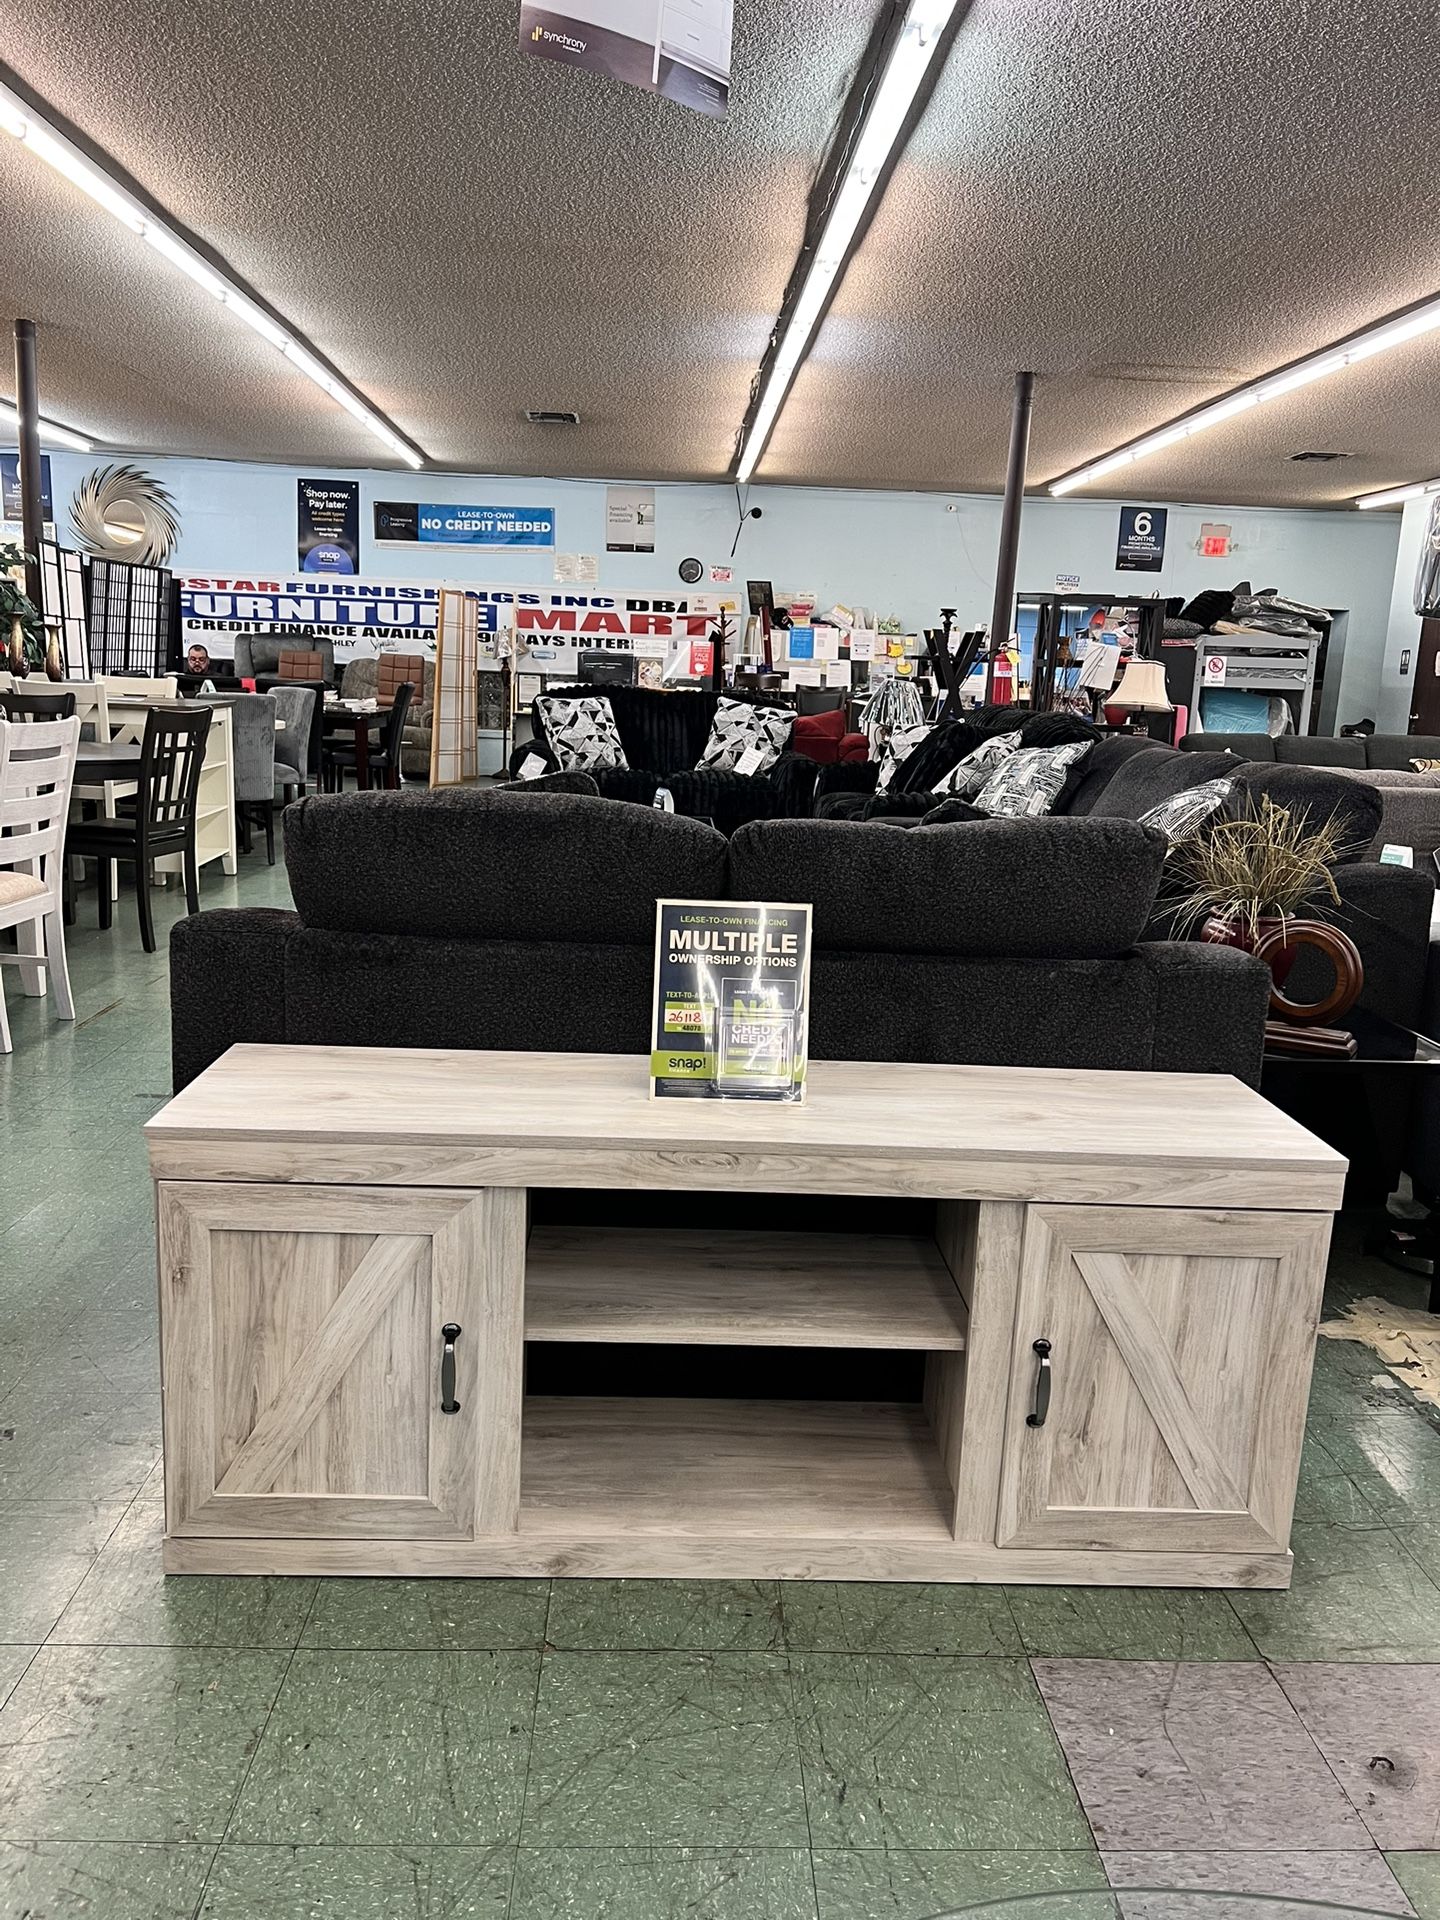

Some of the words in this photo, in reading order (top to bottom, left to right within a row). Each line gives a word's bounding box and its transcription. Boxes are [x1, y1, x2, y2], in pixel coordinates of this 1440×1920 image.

[543, 30, 587, 51] synchrony
[305, 488, 328, 499] Shop
[329, 491, 351, 500] now.
[309, 499, 325, 510] Pay
[325, 500, 348, 509] later.
[457, 510, 515, 520] LEASE-TO-OWN
[421, 518, 442, 531] NO
[445, 519, 492, 532] CREDIT
[496, 520, 551, 533] NEEDED
[1133, 511, 1152, 536] 6
[1128, 535, 1156, 543] MONTHS
[1204, 537, 1227, 555] EXIT
[318, 551, 341, 561] snap
[180, 578, 281, 592] STAR
[286, 582, 541, 604] FURNISHNGS
[551, 595, 615, 608] INC
[516, 608, 718, 636] MART
[187, 619, 264, 633] CREDIT
[268, 621, 357, 637] FINANCE
[362, 626, 436, 641] AVAILA
[477, 632, 496, 643] 9
[680, 915, 742, 925] LEASE-TO-OWN
[669, 929, 798, 954] MULTIPLE
[668, 953, 741, 965] OWNERSHIP
[744, 956, 798, 967] OPTIONS
[668, 1010, 702, 1023] 26118
[668, 1057, 707, 1071] snap!
